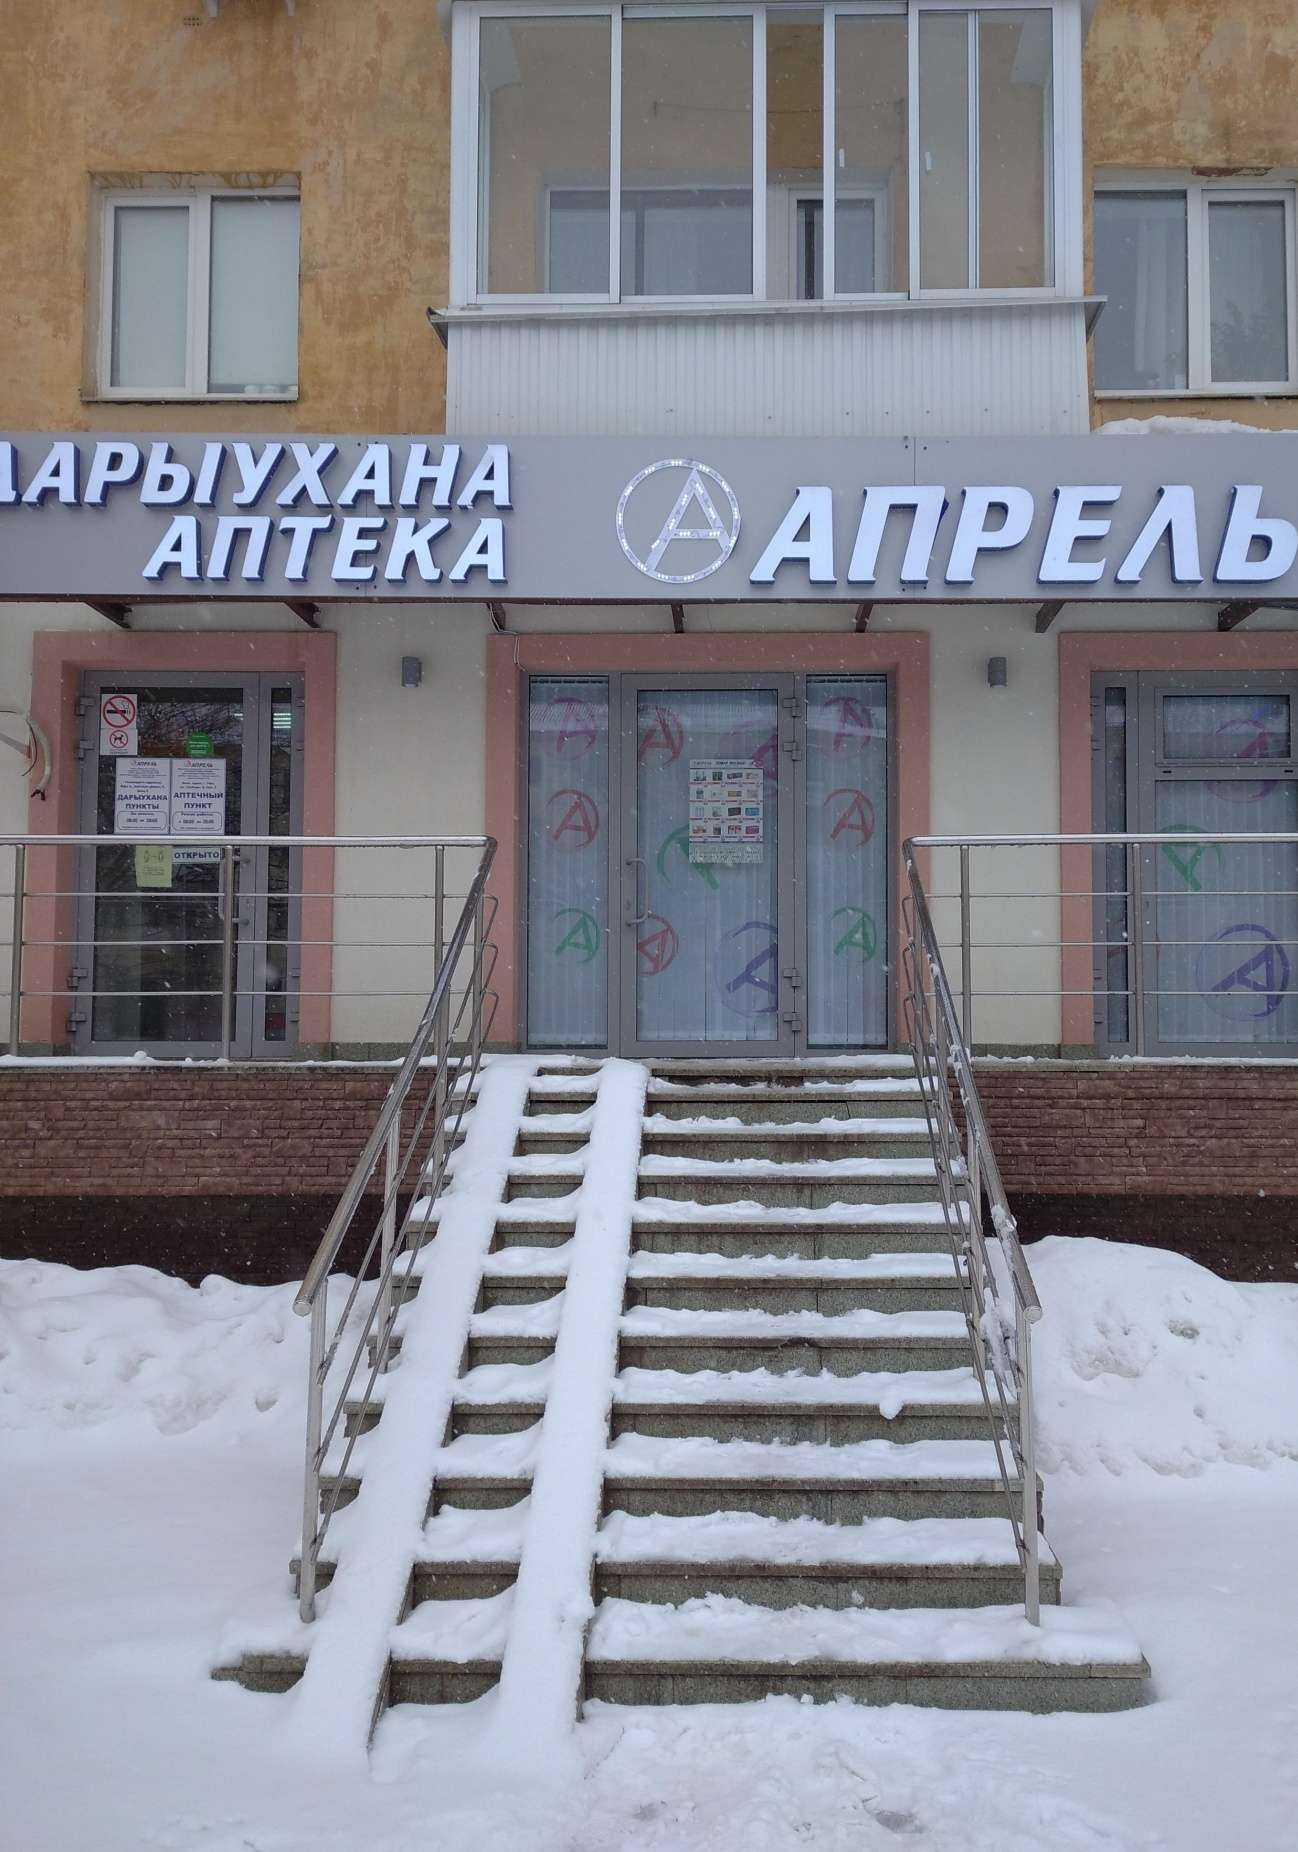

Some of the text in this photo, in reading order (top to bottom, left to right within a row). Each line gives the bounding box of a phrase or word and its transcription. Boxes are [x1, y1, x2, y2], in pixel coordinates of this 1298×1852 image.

[142, 515, 508, 582] АПТЕКА
[646, 466, 734, 572] А
[750, 484, 1298, 584] АПРЕЛЬ
[174, 851, 220, 859] ОТКРЫТО
